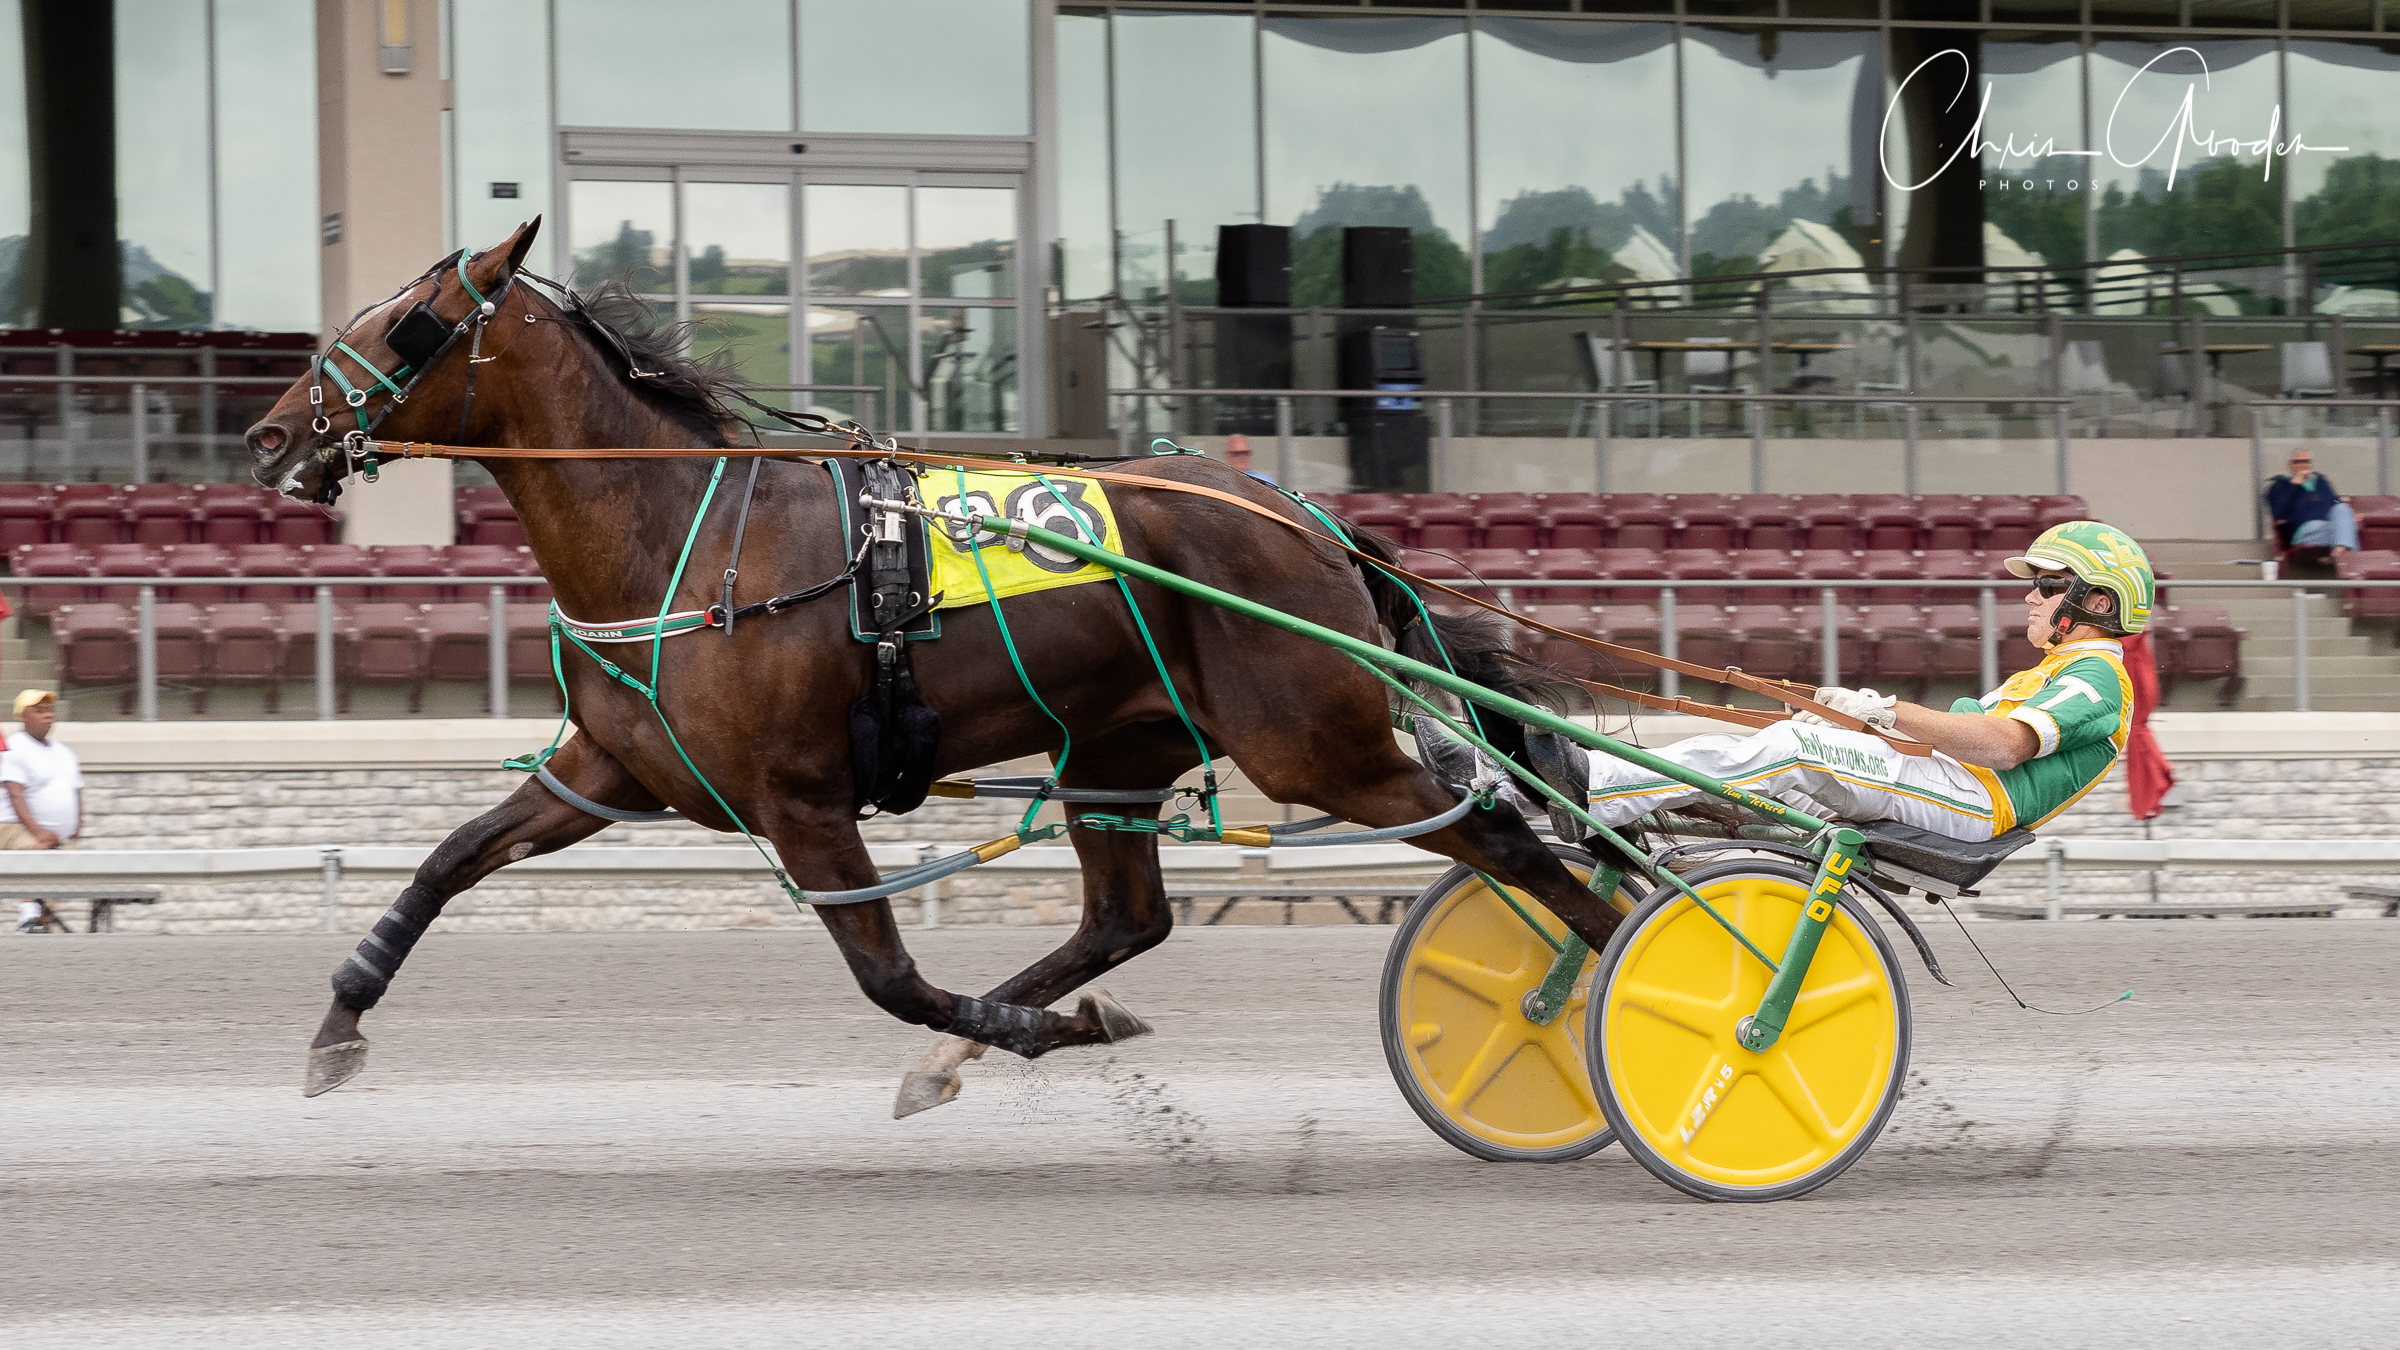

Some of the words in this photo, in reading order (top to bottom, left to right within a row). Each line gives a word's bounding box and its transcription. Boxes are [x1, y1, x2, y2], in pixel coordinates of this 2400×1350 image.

[2037, 675, 2103, 710] T
[1721, 783, 1743, 799] Tim
[1806, 851, 1853, 923] UFO
